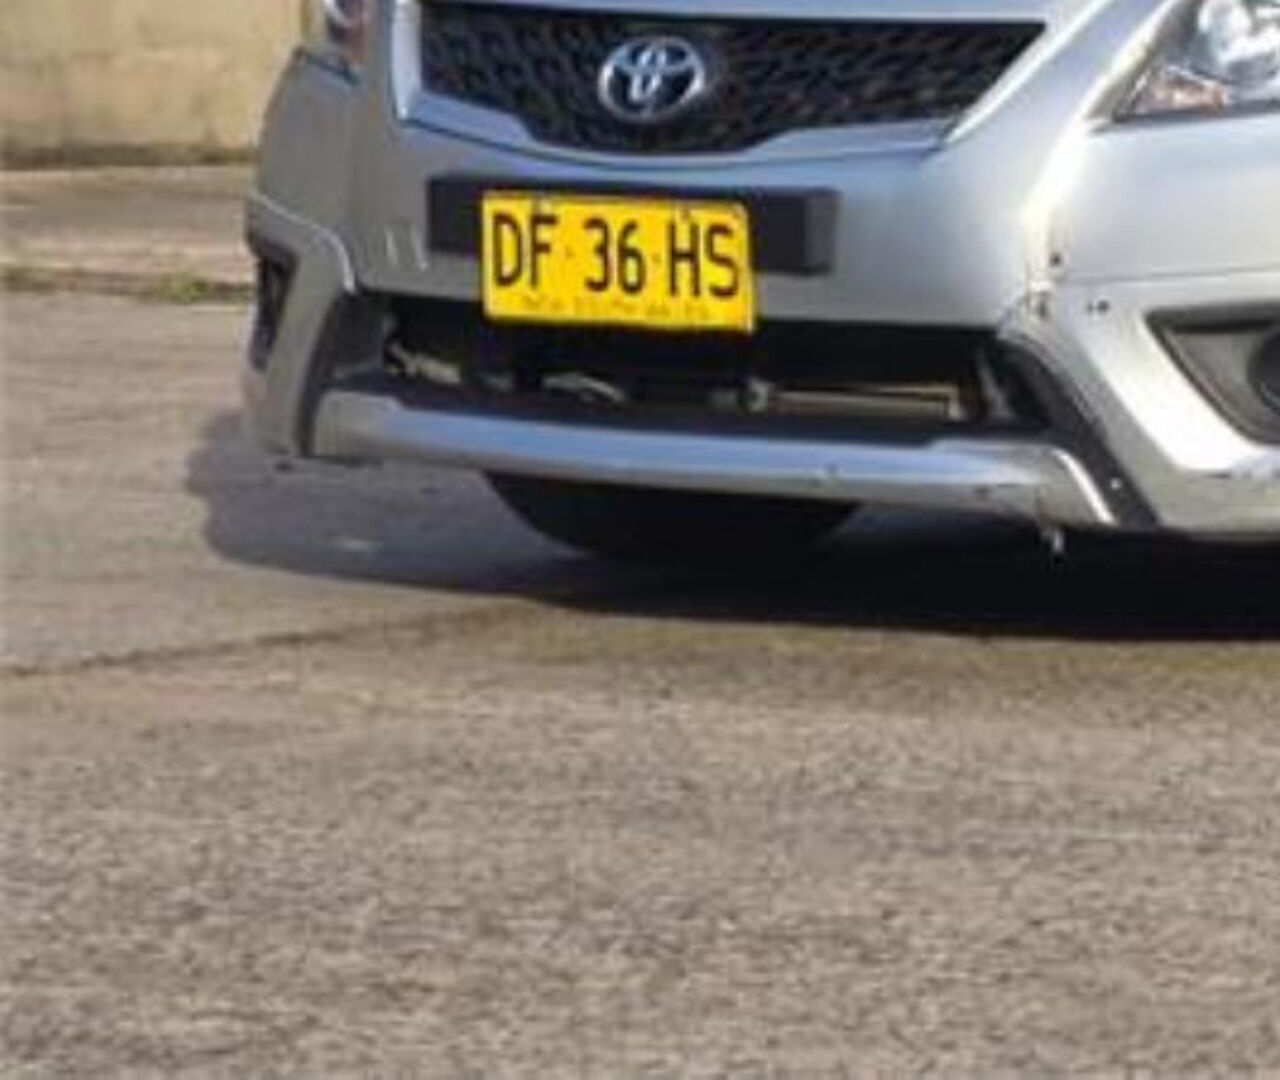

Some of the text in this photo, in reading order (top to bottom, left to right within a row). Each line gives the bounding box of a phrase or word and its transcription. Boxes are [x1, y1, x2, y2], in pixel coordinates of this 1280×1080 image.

[492, 213, 740, 299] DF 36 HS
